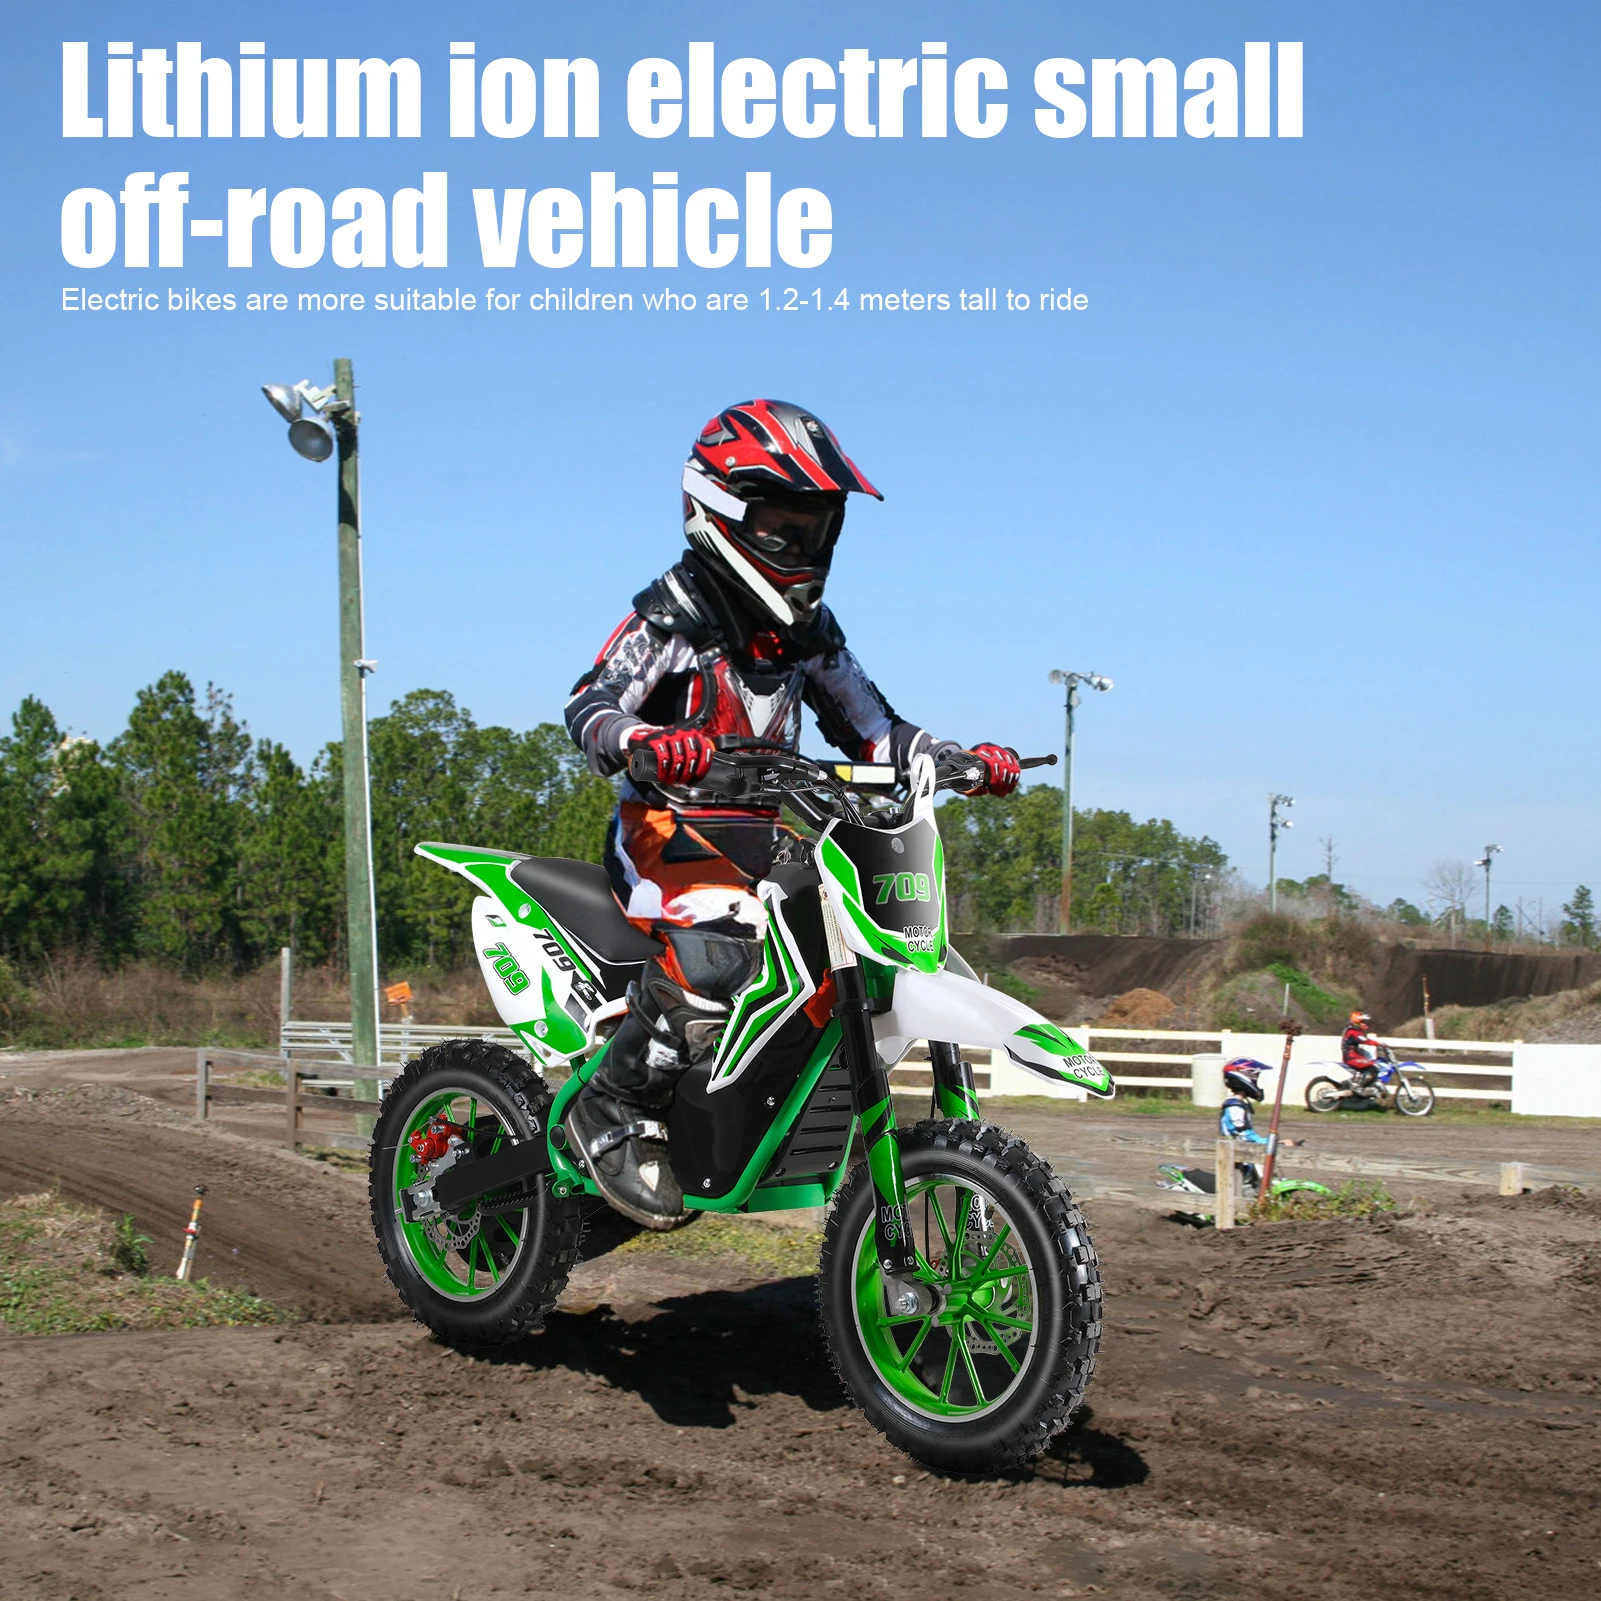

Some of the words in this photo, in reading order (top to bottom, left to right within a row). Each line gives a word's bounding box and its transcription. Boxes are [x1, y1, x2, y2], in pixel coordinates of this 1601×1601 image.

[873, 872, 931, 905] 709
[904, 926, 933, 939] MOTOR
[532, 928, 577, 972] 709
[907, 940, 934, 952] CYCLE
[482, 942, 531, 996] 709
[1073, 1066, 1106, 1079] CYCLE
